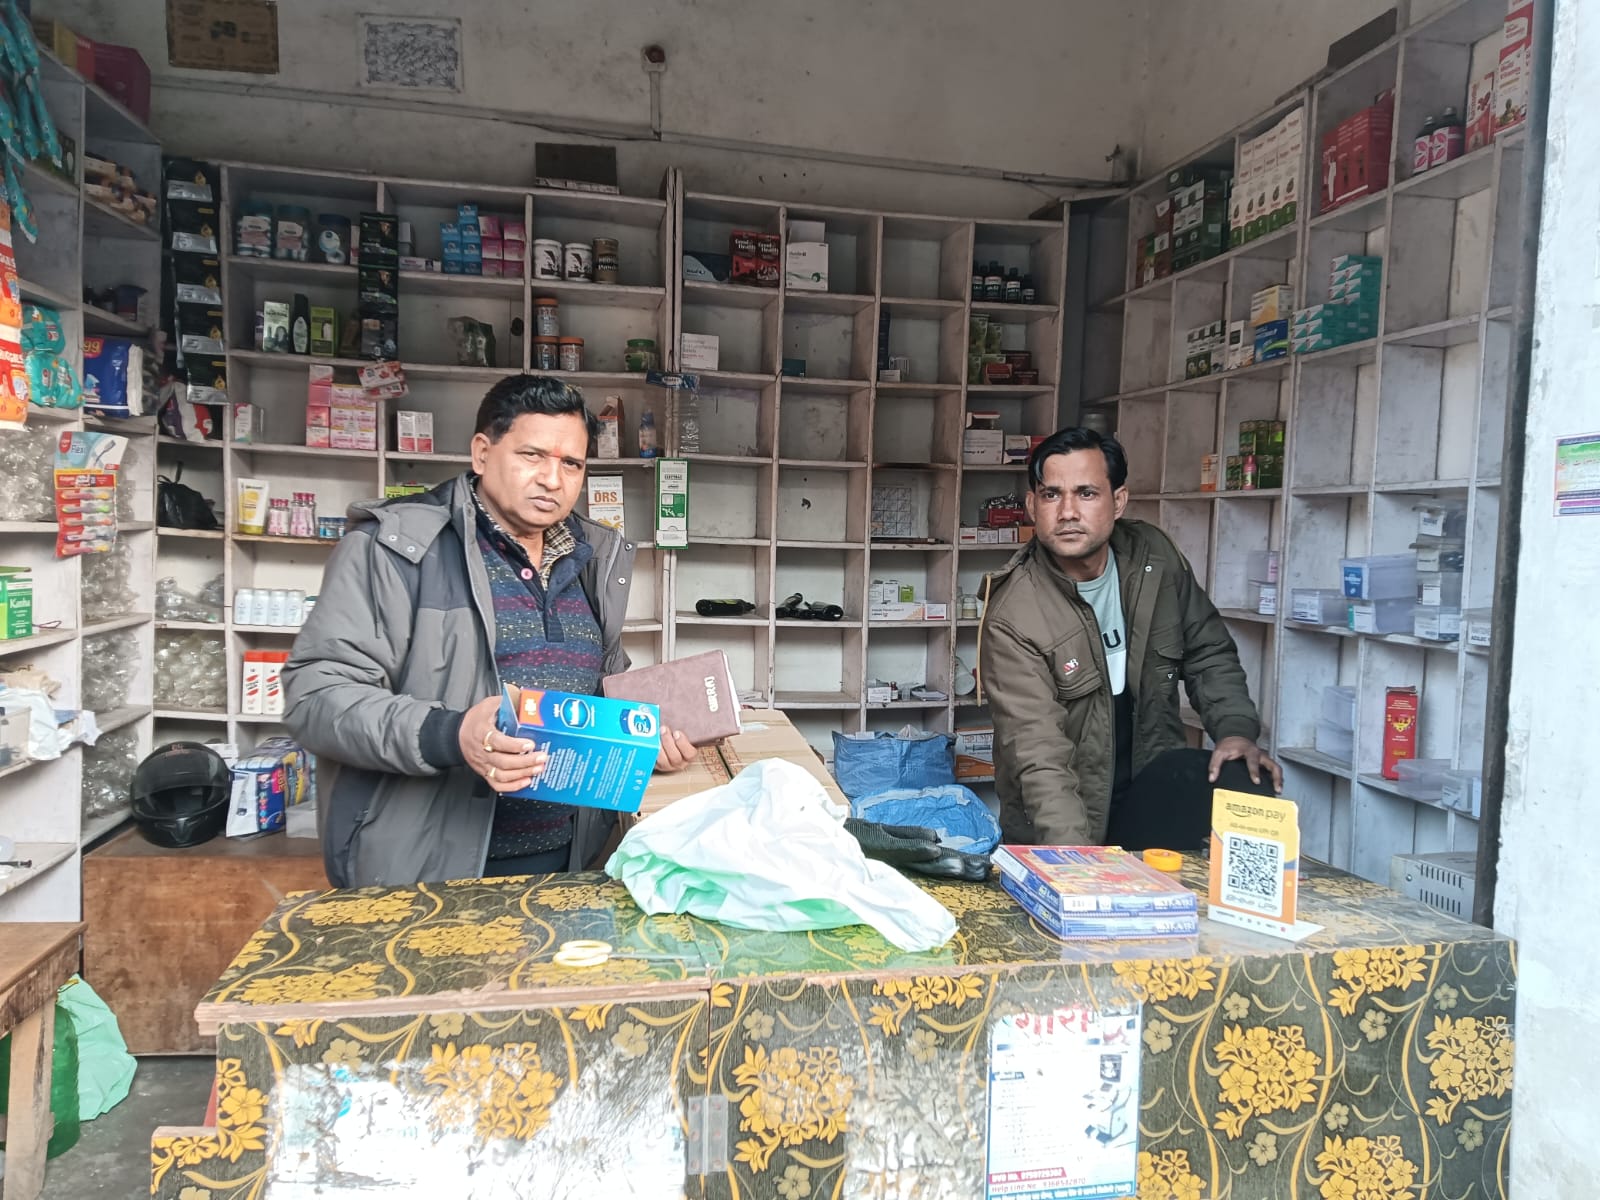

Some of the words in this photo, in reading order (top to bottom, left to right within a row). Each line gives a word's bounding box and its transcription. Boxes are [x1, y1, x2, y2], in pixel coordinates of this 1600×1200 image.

[735, 238, 749, 246] Good
[761, 247, 779, 255] Health
[1225, 802, 1265, 817] amazon
[1265, 809, 1286, 823] pay
